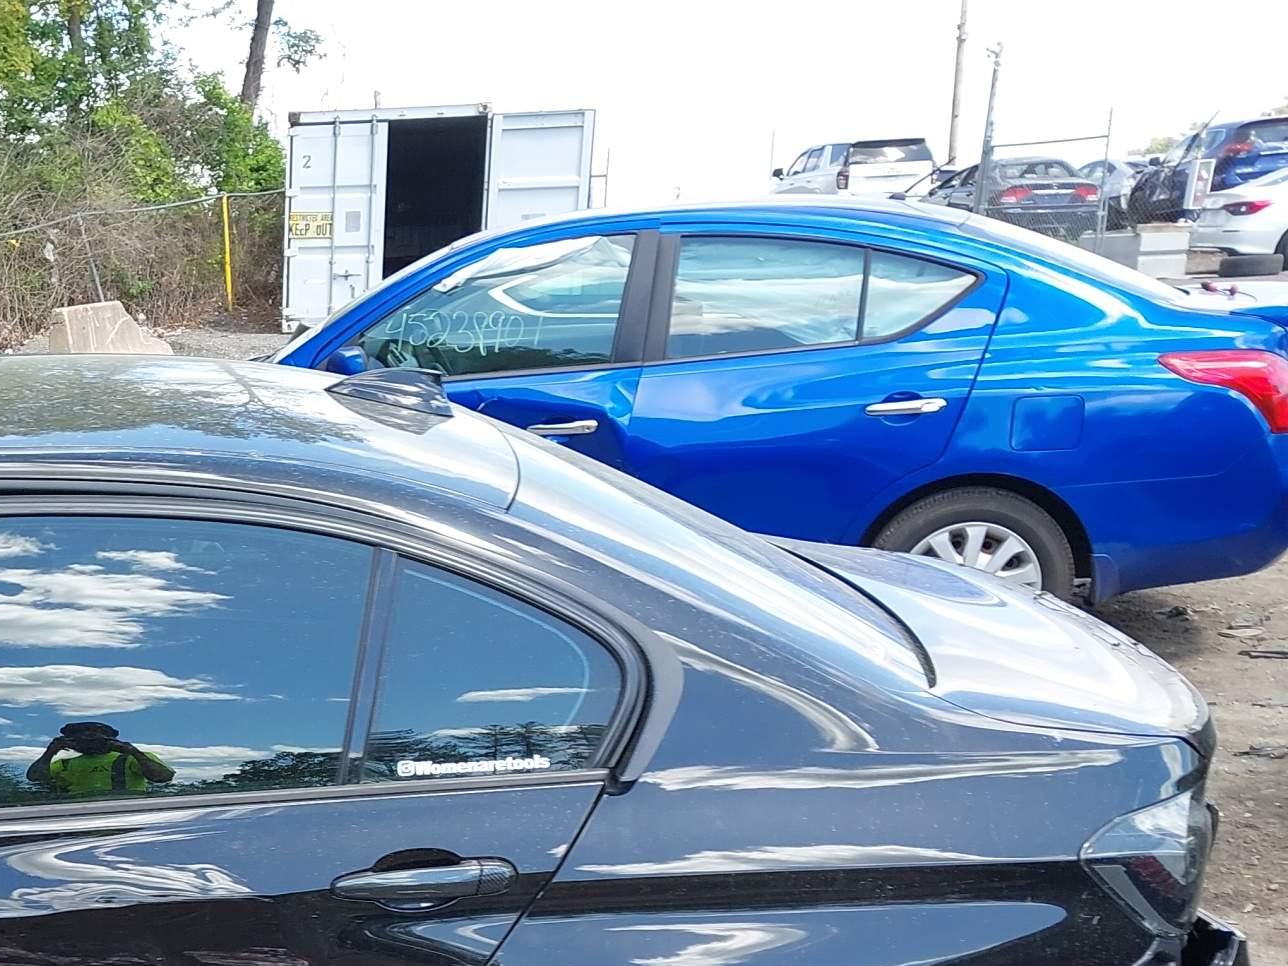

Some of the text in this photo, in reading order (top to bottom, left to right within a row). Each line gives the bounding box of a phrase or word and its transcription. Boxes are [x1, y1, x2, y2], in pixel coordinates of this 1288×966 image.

[302, 154, 311, 168] 2
[289, 223, 333, 236] KEEP OUT
